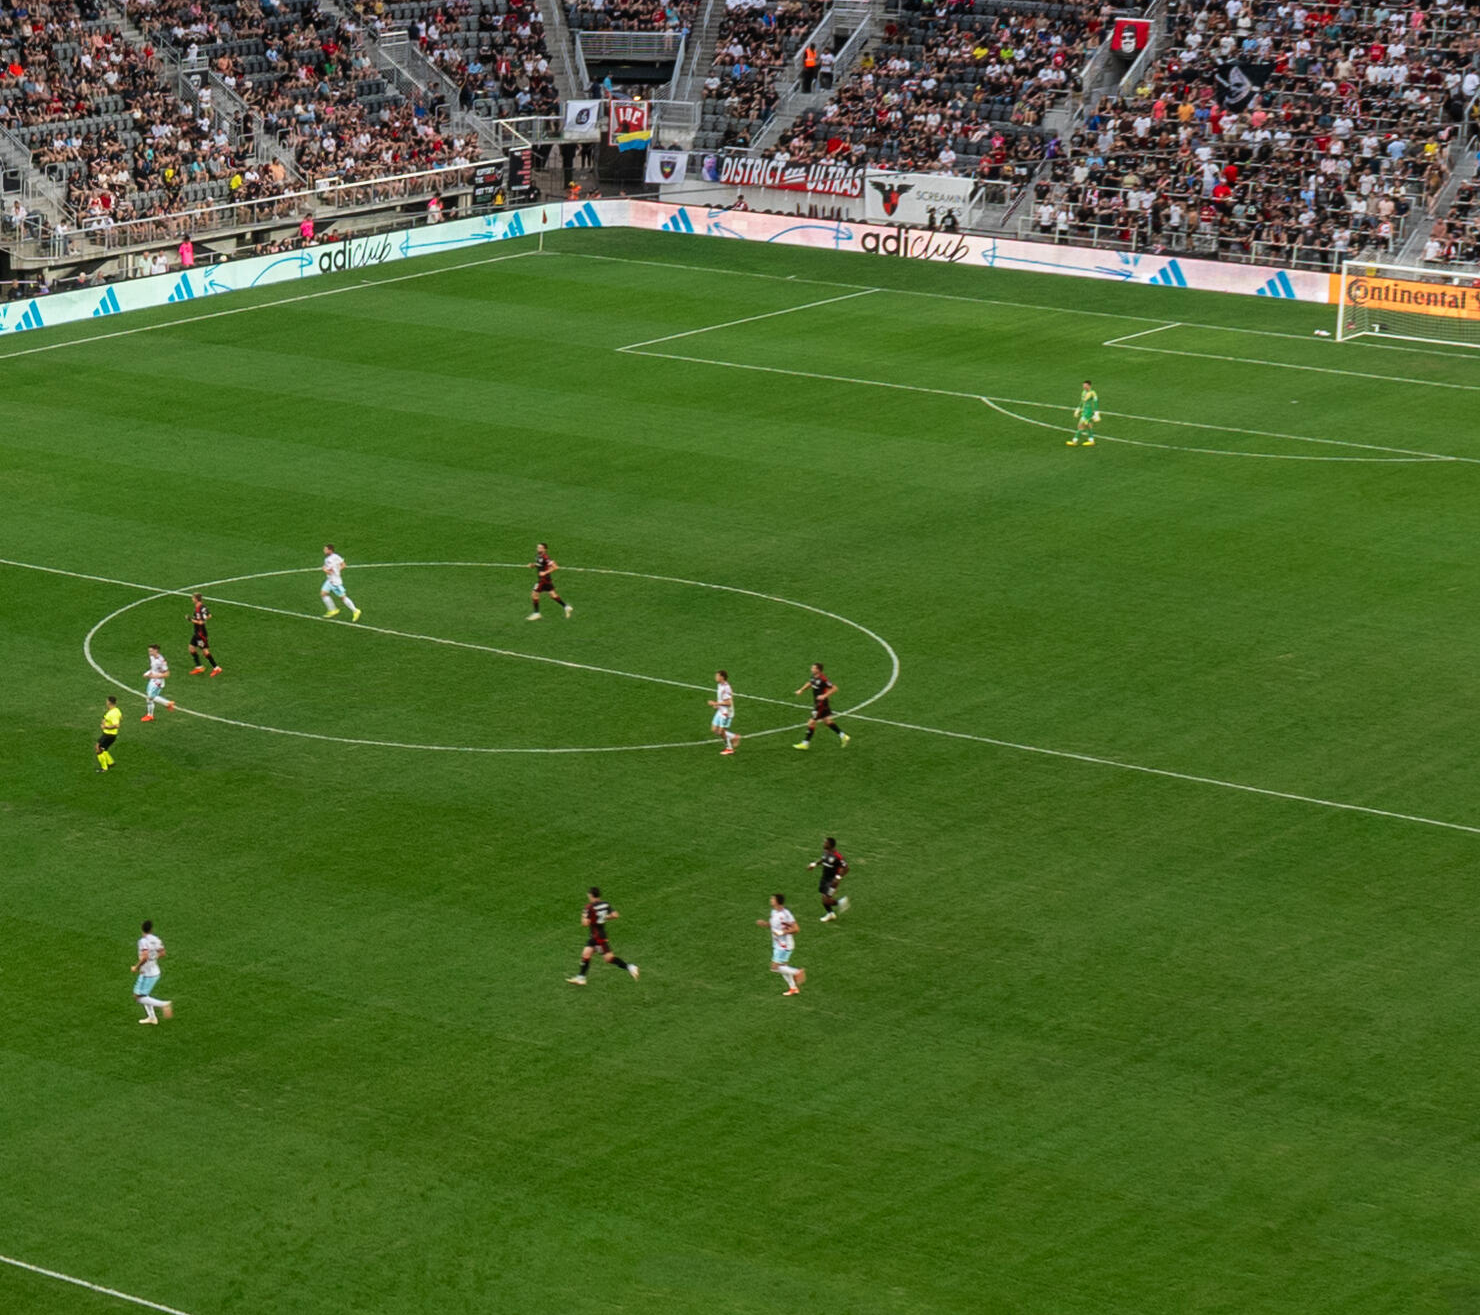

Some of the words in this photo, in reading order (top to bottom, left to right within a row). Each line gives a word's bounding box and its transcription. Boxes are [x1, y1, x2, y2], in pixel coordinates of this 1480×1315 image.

[720, 155, 787, 186] DISTRICT
[806, 164, 865, 196] ULTRAS
[1347, 279, 1467, 310] Continental
